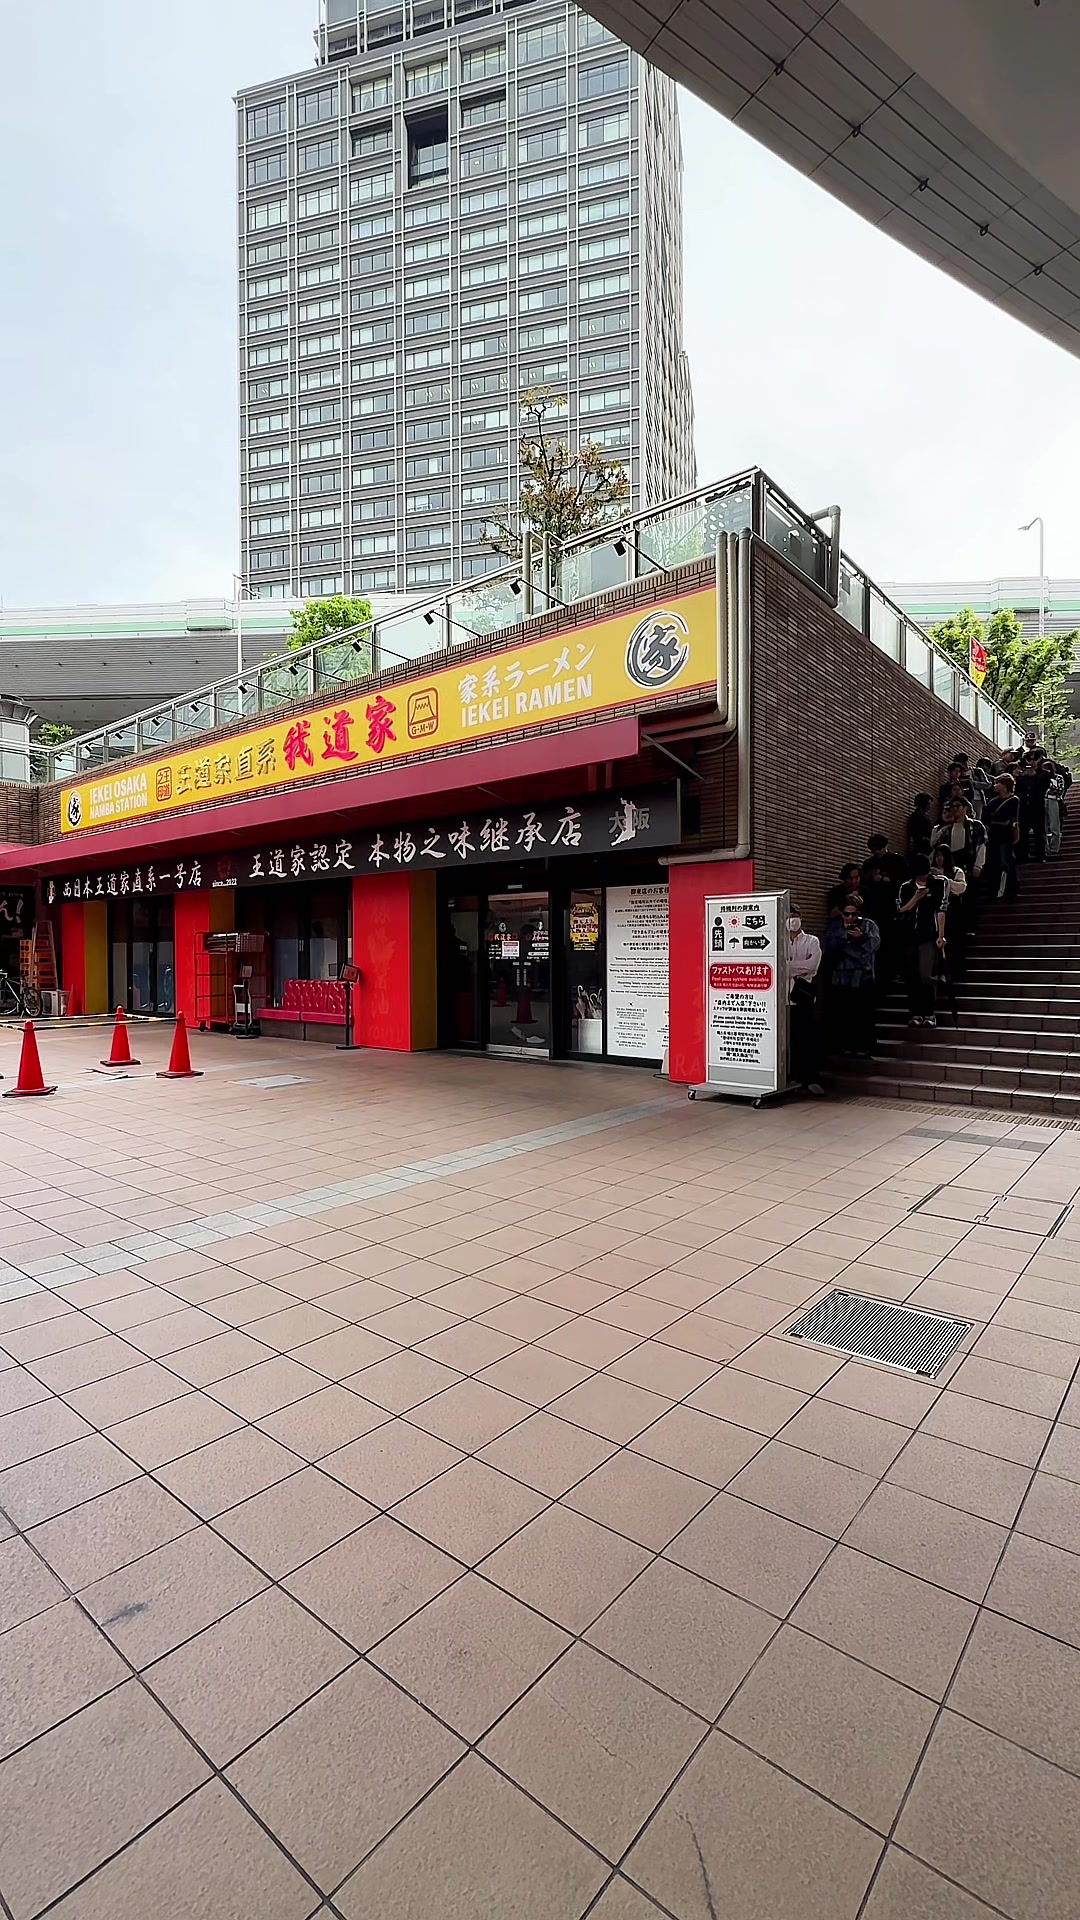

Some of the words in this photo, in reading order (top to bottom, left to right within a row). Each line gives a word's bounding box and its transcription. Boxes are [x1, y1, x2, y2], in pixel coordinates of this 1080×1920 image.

[457, 641, 598, 705] 家系ラーメン
[461, 697, 509, 728] IEKEI
[516, 674, 593, 715] RAMEN
[283, 695, 397, 771] 我道家
[89, 782, 113, 806] IEKEI
[115, 772, 147, 799] OSAKA
[89, 803, 115, 820] NAMBA
[115, 793, 148, 813] STATION
[248, 838, 356, 878] 王道家認定
[62, 860, 202, 899] 西日本王道家直系一号店
[714, 930, 723, 948] 先頭
[746, 917, 764, 926] こちら
[712, 965, 769, 975] ファストパスあります
